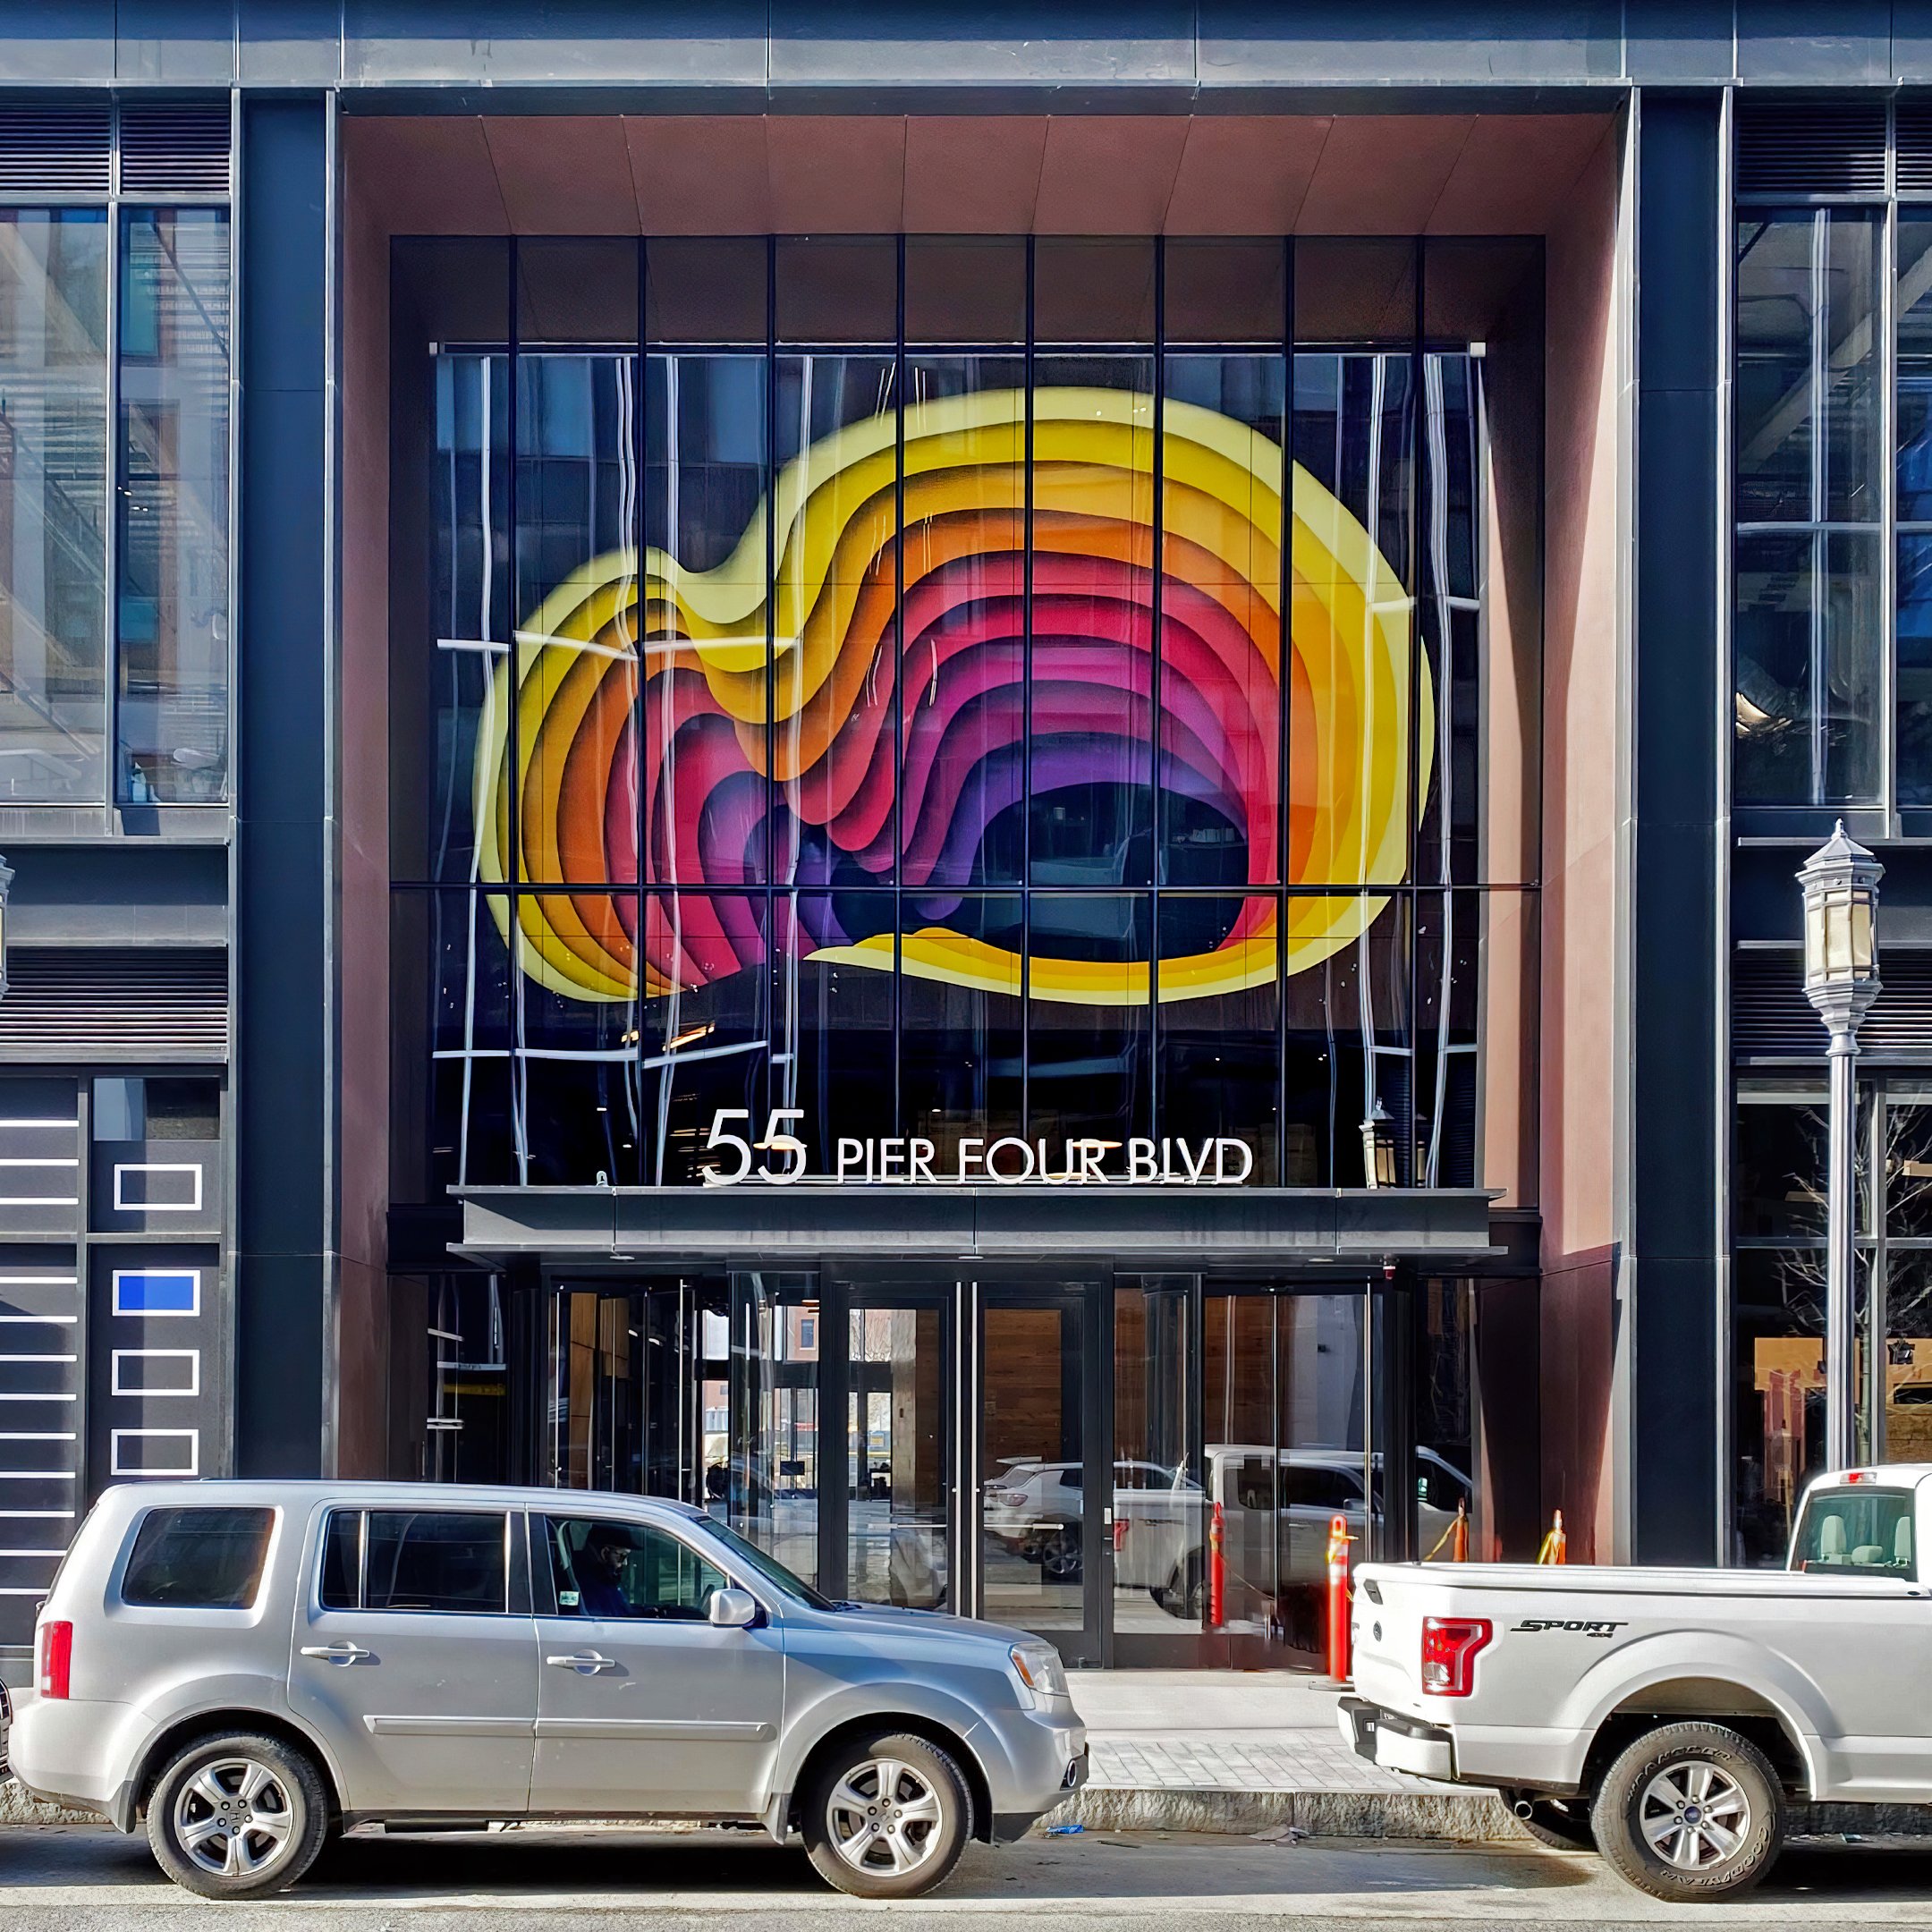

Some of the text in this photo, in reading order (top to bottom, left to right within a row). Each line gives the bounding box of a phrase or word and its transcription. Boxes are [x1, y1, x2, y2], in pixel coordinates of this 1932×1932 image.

[702, 1109, 1253, 1185] 55 PIER FOUR BLVD
[1510, 1620, 1629, 1631] SPORT
